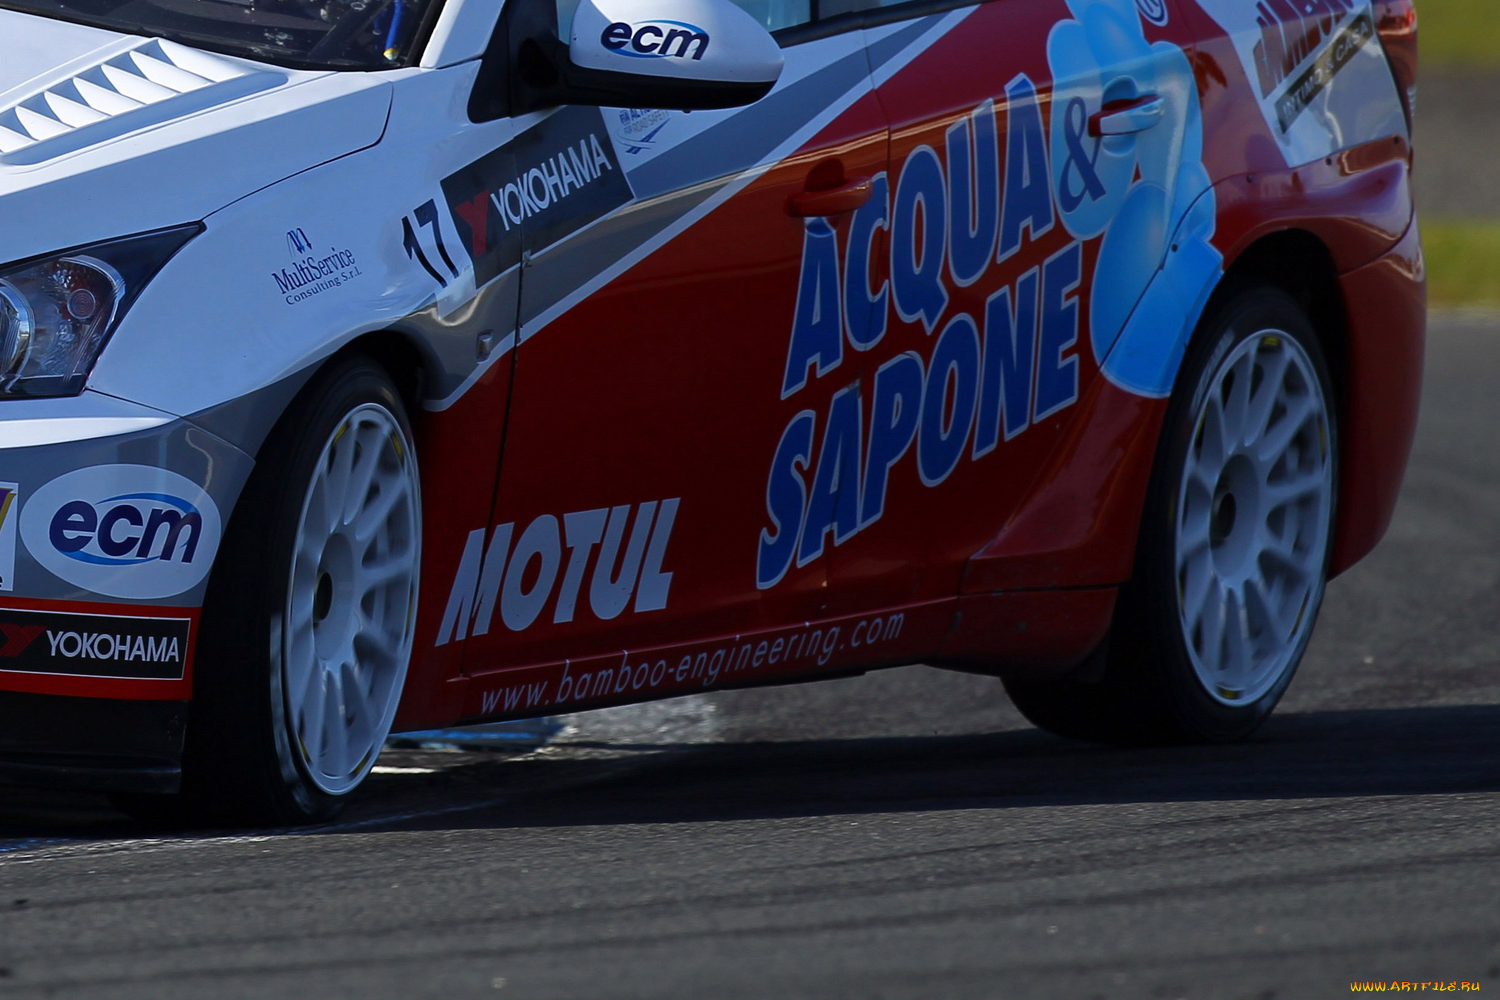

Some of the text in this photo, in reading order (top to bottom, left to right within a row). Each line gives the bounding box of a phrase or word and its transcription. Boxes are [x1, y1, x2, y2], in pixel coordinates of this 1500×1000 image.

[601, 22, 709, 60] ecm
[489, 132, 613, 232] YOKOHAMA
[271, 246, 356, 294] MultiService
[401, 198, 461, 289] 17
[780, 72, 1107, 400] ACQUA &
[285, 276, 342, 305] Consulting
[756, 240, 1082, 590] SAPONE
[48, 499, 203, 564] ecm
[435, 497, 682, 648] MOTUL
[46, 630, 180, 663] YOKOHAMA
[480, 611, 905, 716] www.bamboo-engineering.com
